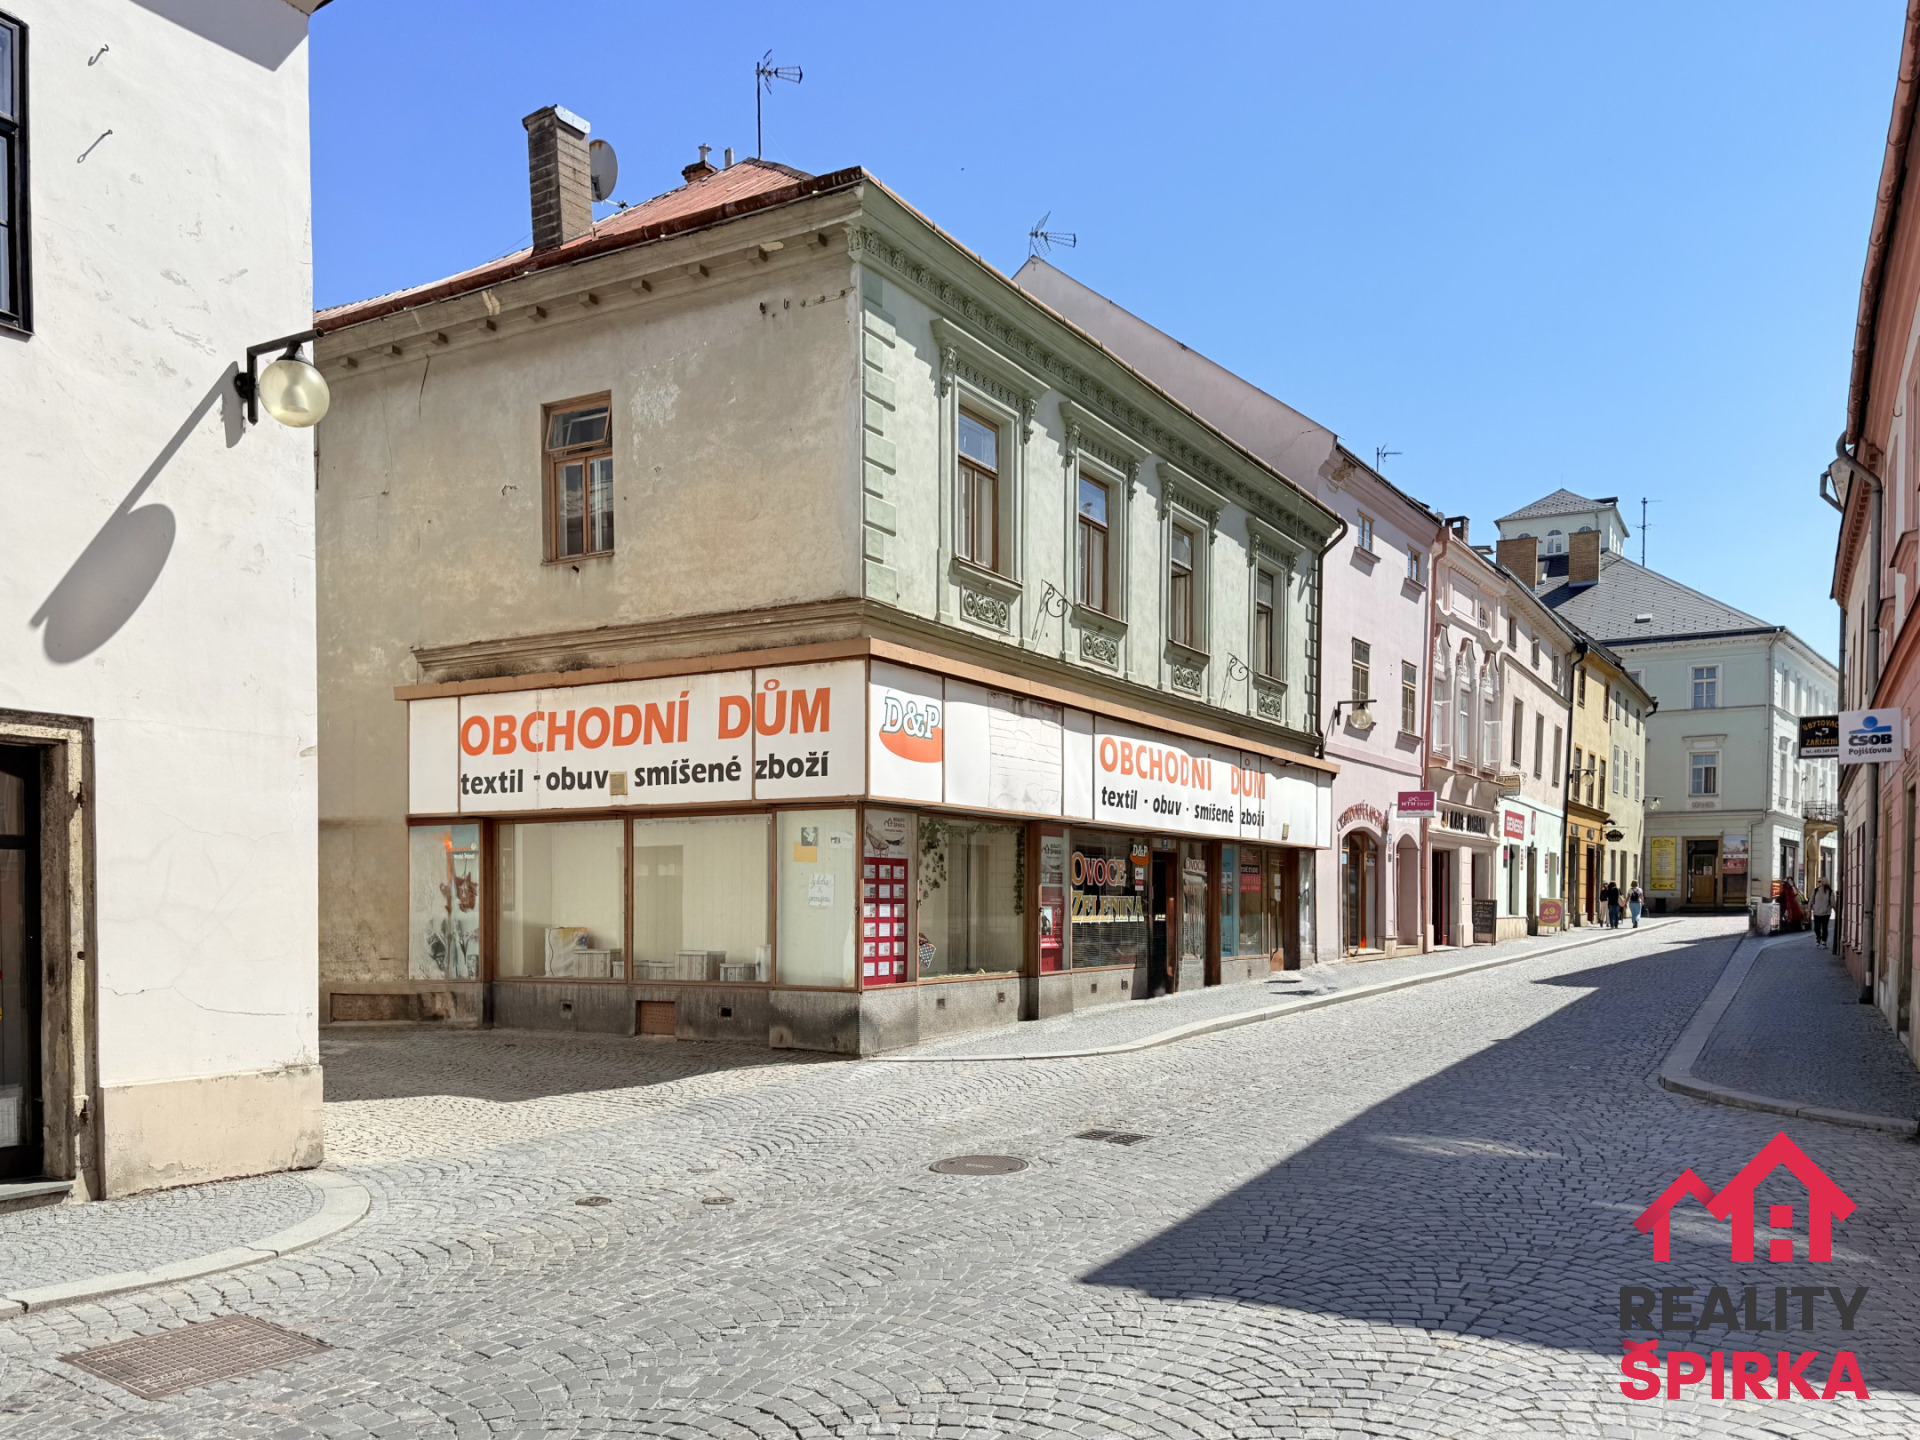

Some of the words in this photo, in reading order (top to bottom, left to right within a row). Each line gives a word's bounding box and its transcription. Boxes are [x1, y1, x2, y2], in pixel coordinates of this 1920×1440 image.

[461, 690, 690, 756] OBCHODNÍ
[718, 678, 831, 739] DŮM
[882, 696, 941, 740] D&P
[1848, 734, 1893, 747] ČSOB
[1848, 746, 1893, 757] Pojišťovna
[461, 769, 523, 795] textil
[546, 766, 609, 791] obuv
[634, 755, 742, 787] smíšené
[755, 751, 829, 780] zboží
[1100, 737, 1212, 791] OBCHODNÍ
[1231, 758, 1266, 799] DŮM
[1102, 786, 1138, 810] textil
[1153, 795, 1182, 816] obuv
[1194, 803, 1234, 824] smíšené
[1241, 808, 1265, 828] zboží
[1071, 852, 1127, 886] OVOCE
[1132, 844, 1149, 857] D&P
[1071, 890, 1145, 925] ZELENINA
